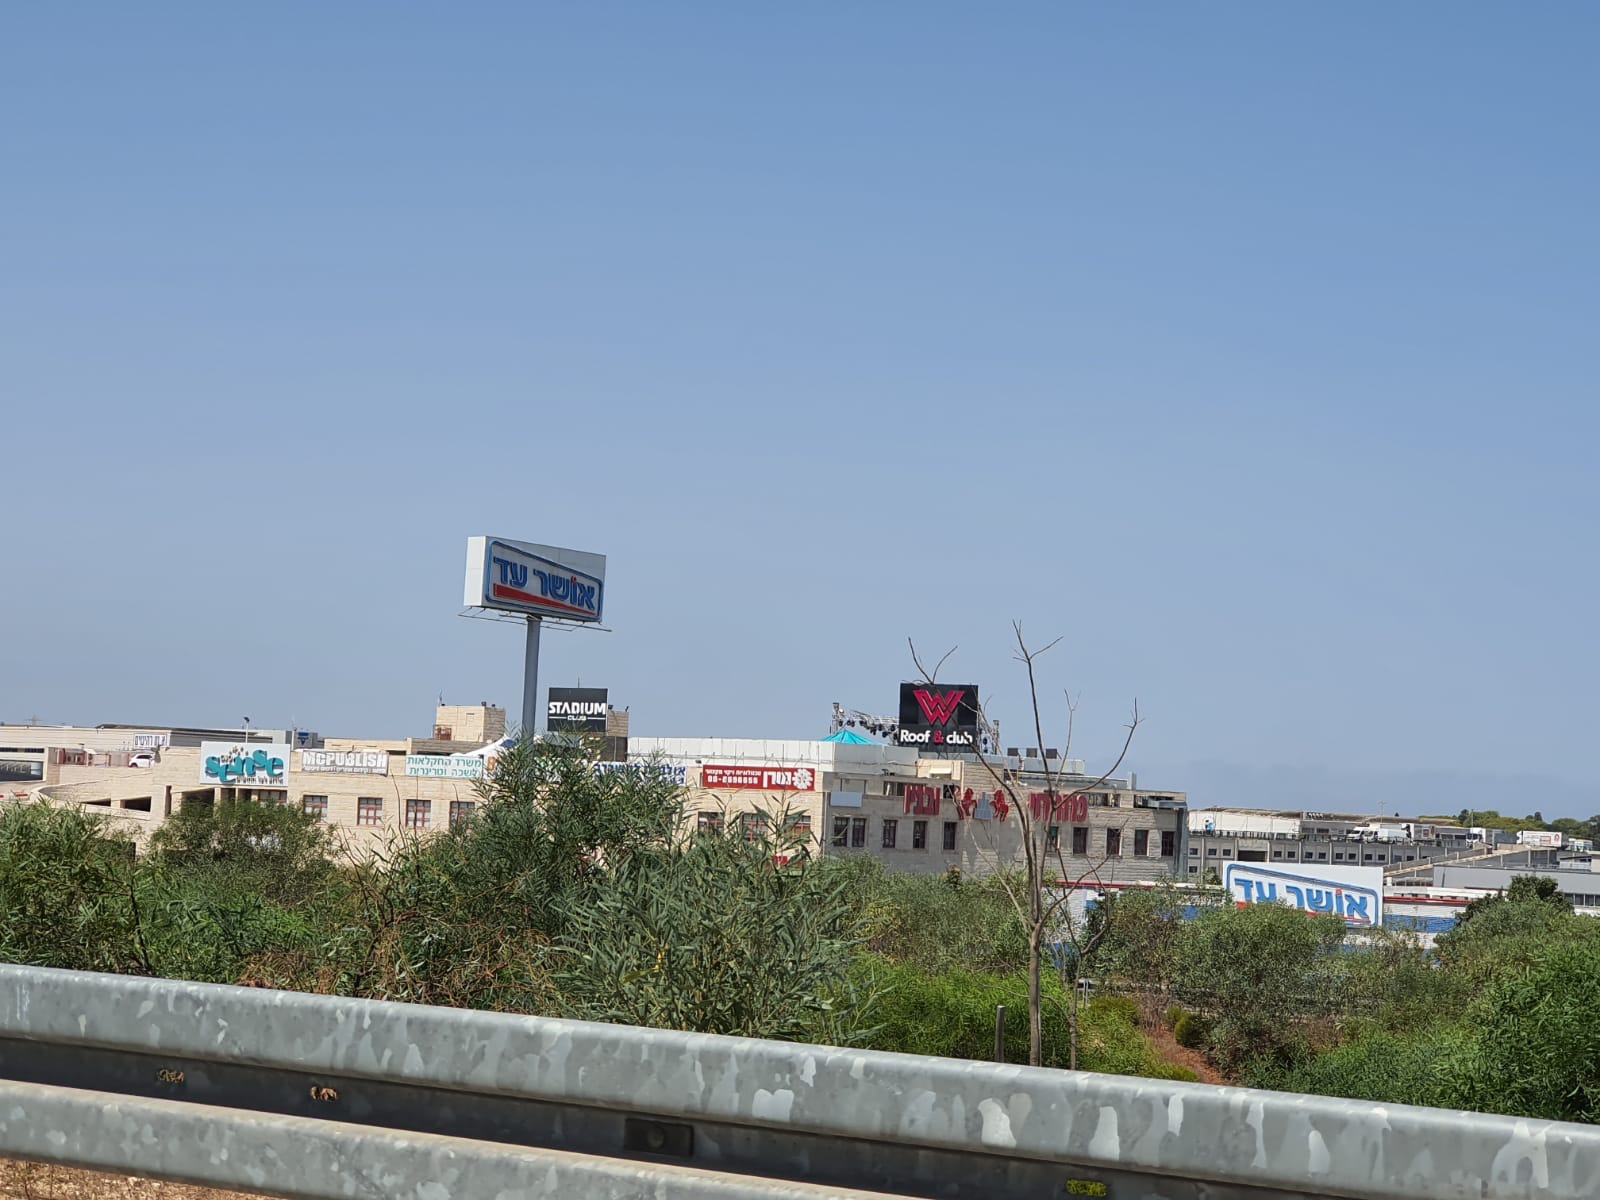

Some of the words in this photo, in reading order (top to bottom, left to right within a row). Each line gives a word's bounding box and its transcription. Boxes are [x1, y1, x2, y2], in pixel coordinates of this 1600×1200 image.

[493, 556, 528, 589] עד
[533, 568, 596, 611] אושר
[548, 701, 607, 715] STADIUM
[913, 689, 965, 727] W
[900, 729, 931, 743] Roof
[946, 730, 973, 745] club
[303, 750, 387, 767] MCPUBLISH
[407, 755, 451, 767] החקלאות
[455, 757, 482, 768] משרד
[409, 766, 447, 776] וטרינרית
[451, 767, 478, 777] לשכה
[1233, 877, 1277, 904] עד
[1285, 887, 1369, 919] אושר
